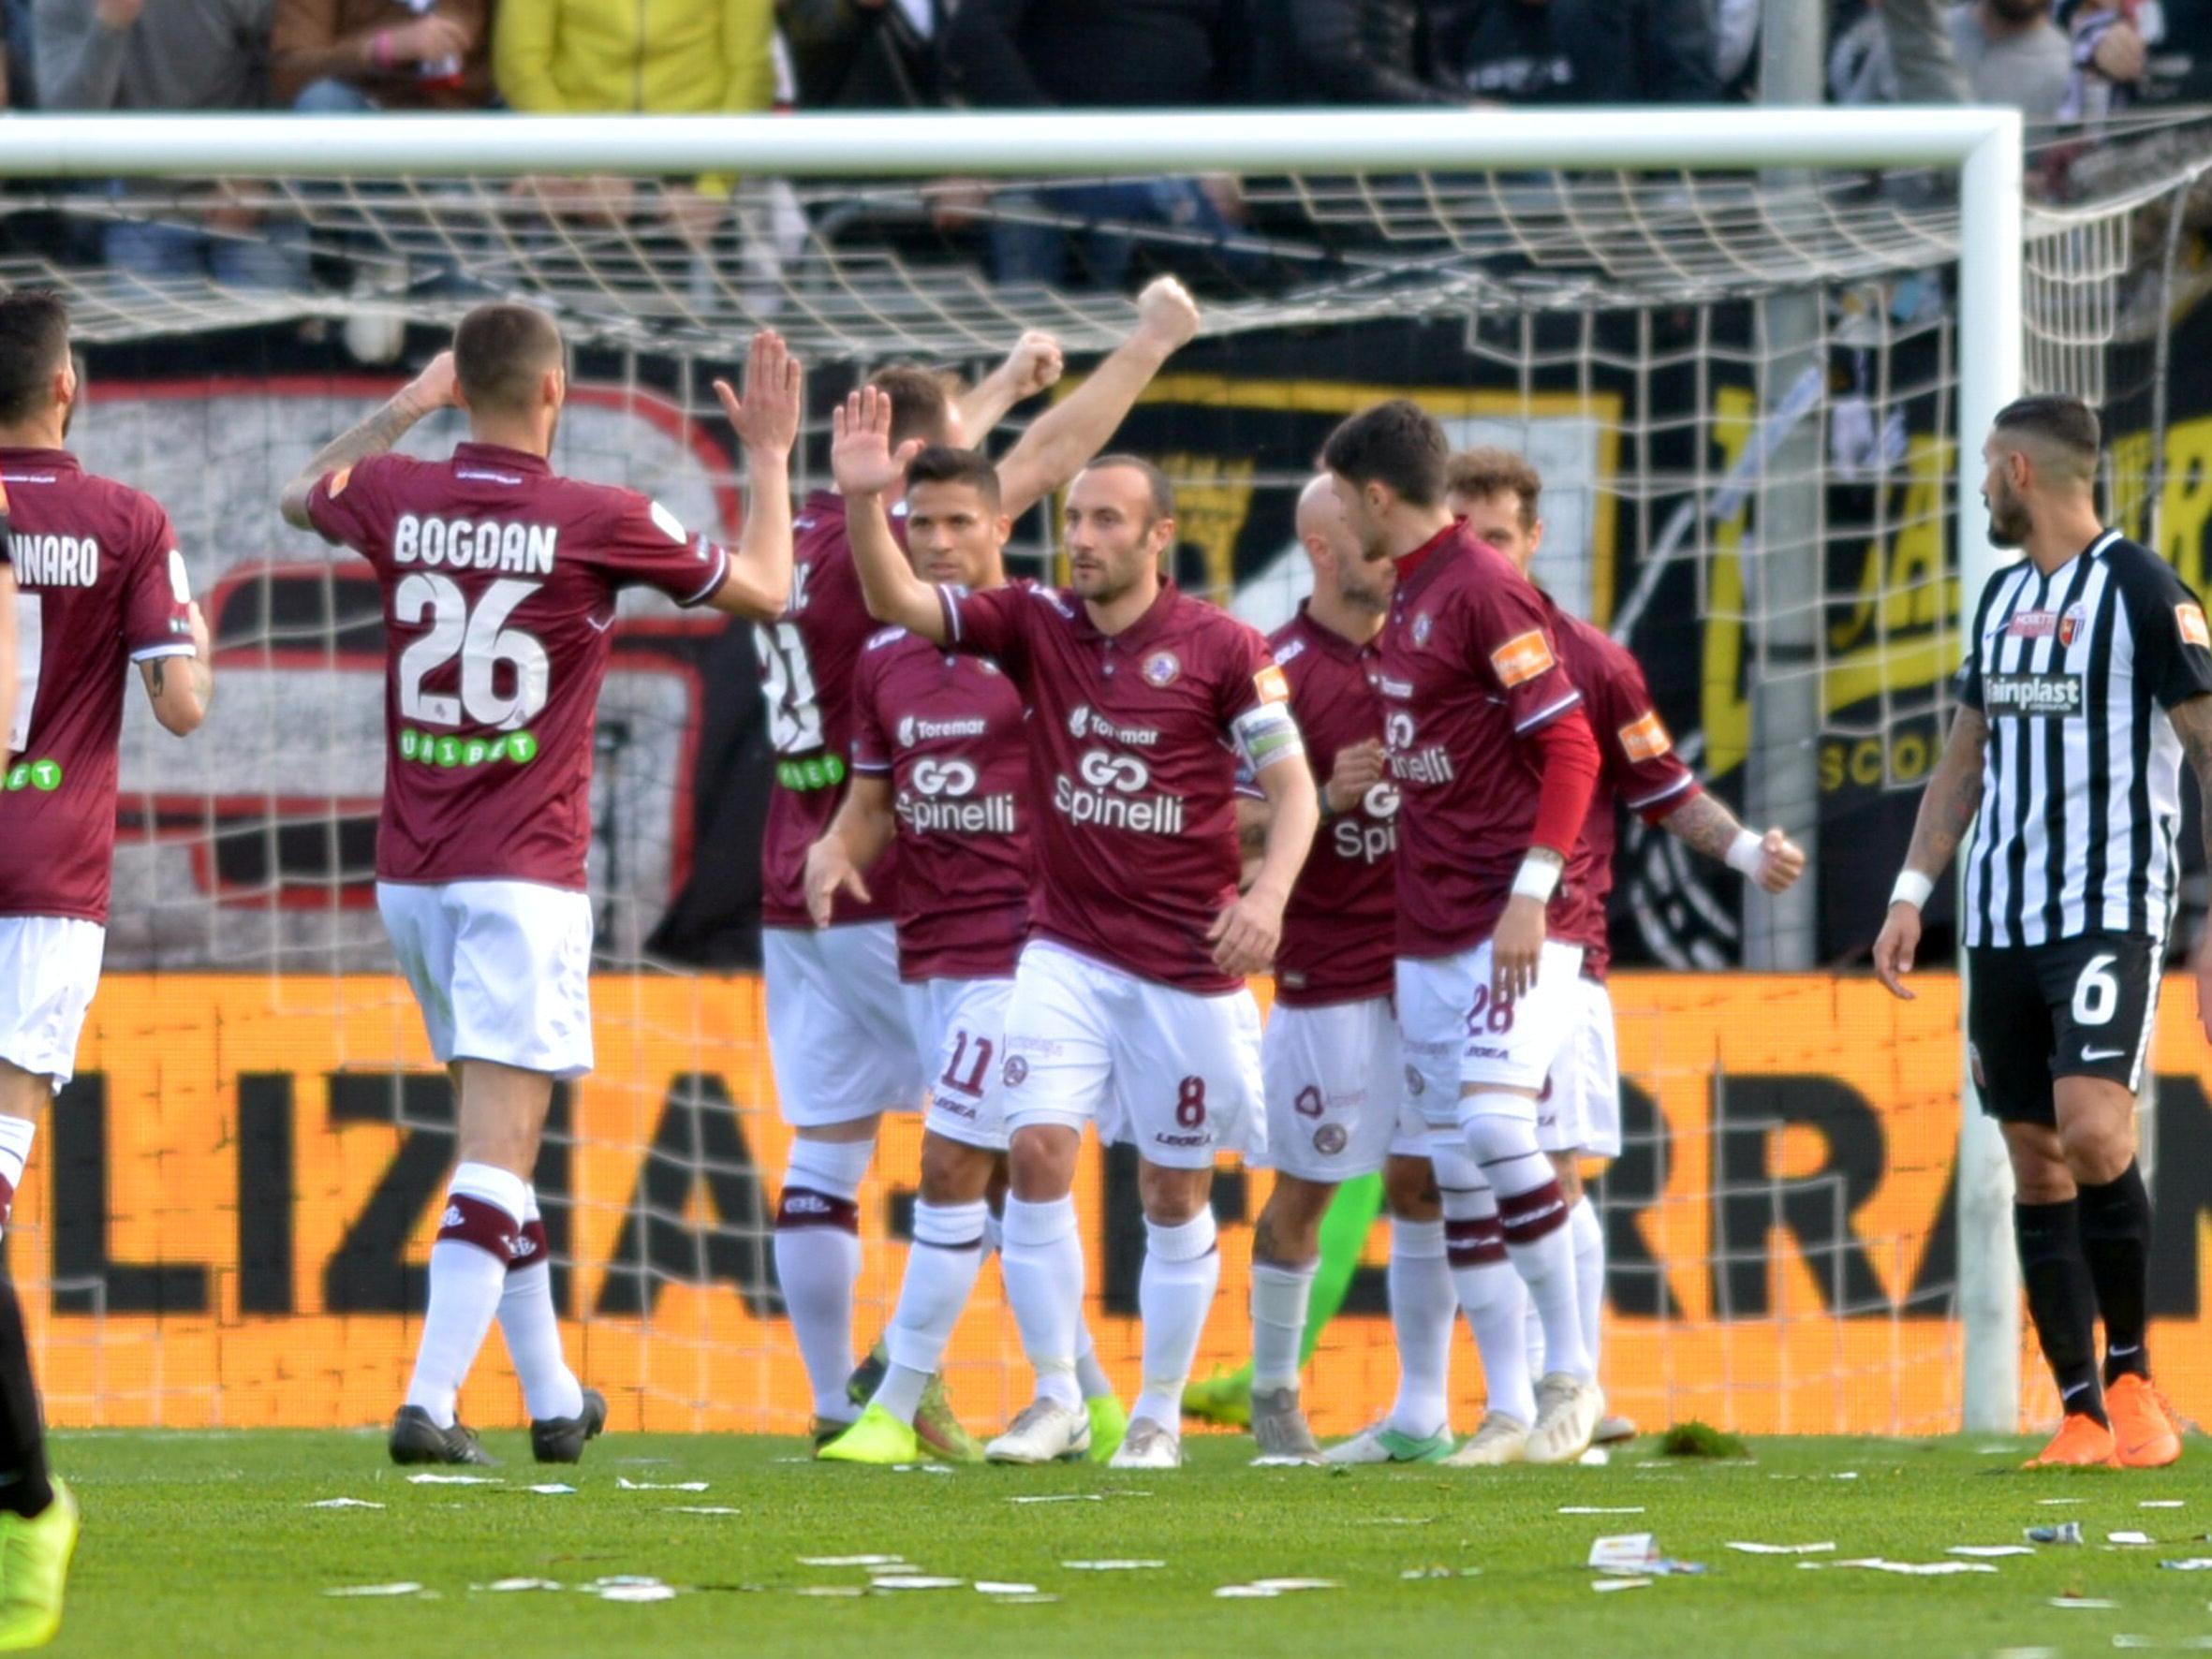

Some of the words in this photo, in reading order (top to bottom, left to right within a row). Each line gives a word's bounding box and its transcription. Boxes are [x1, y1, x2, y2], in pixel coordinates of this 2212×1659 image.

[394, 514, 557, 574] BOGDAN
[395, 571, 550, 730] 26
[918, 719, 985, 739] Toremar
[913, 760, 976, 796] GO
[1081, 751, 1148, 793] GO
[895, 793, 1014, 835] Spinelli
[1055, 774, 1183, 834] Spinelli
[2072, 955, 2117, 1025] 6
[941, 1030, 994, 1098] 11
[1176, 1076, 1206, 1130] 8
